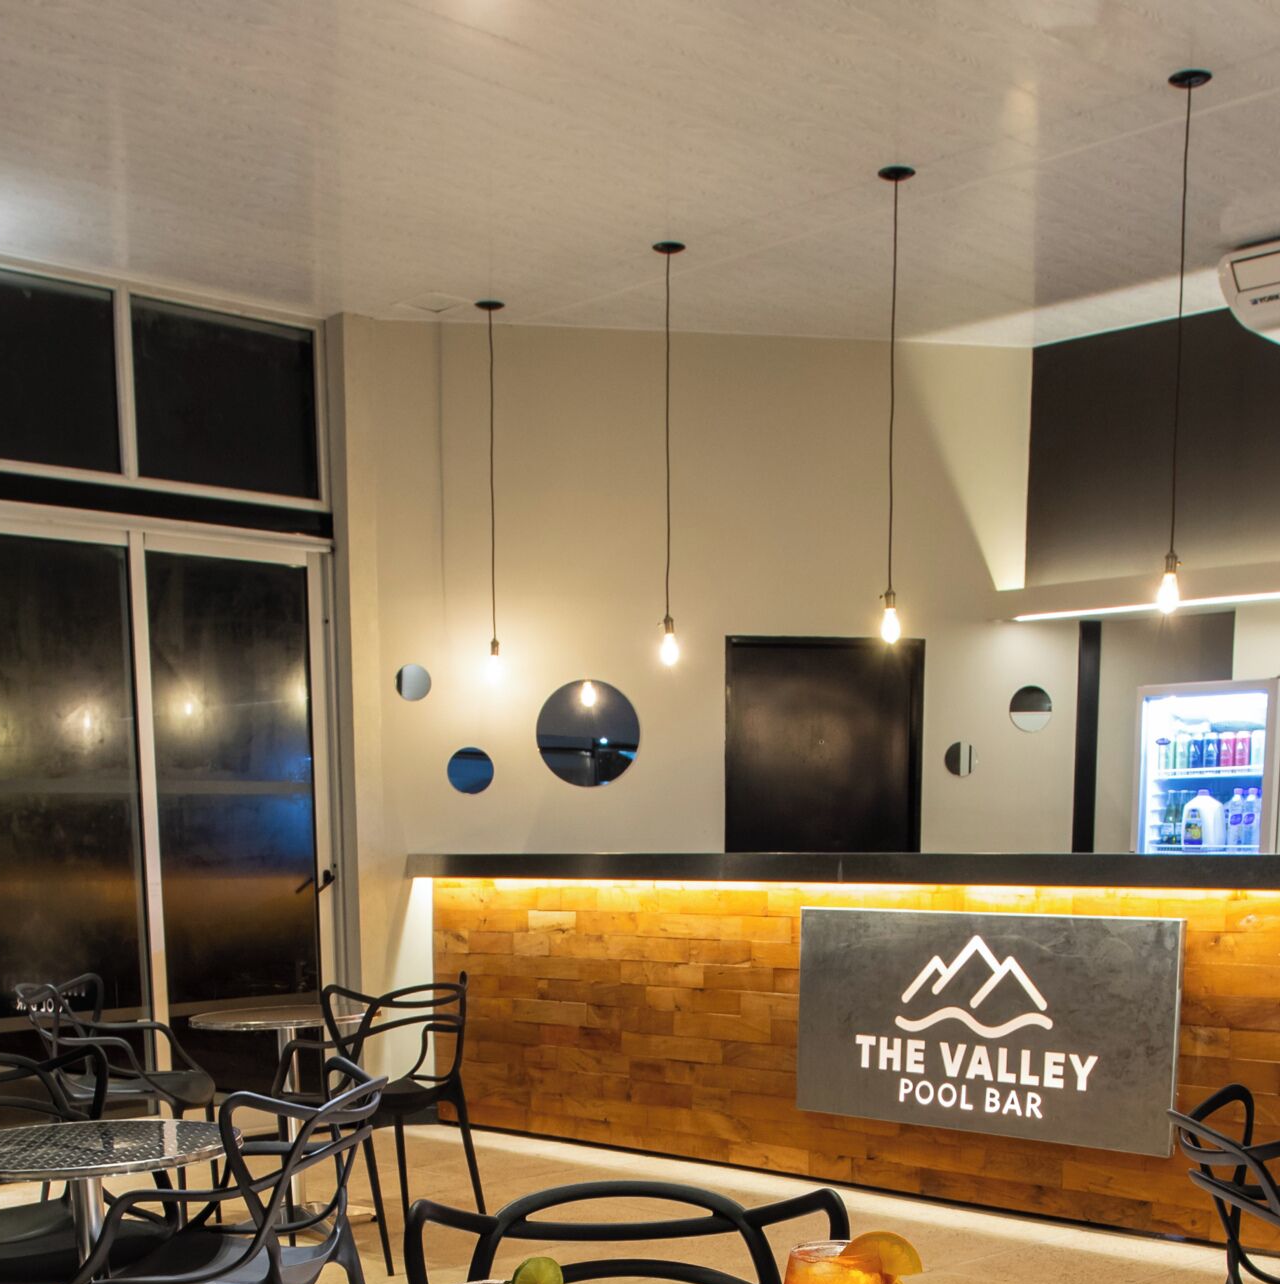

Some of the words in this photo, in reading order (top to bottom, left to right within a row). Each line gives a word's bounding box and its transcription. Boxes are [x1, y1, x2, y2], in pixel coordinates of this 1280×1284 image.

[856, 1034, 926, 1074] THE
[939, 1042, 1099, 1092] VALLEY
[898, 1078, 974, 1111] POOL
[984, 1087, 1043, 1120] BAR
